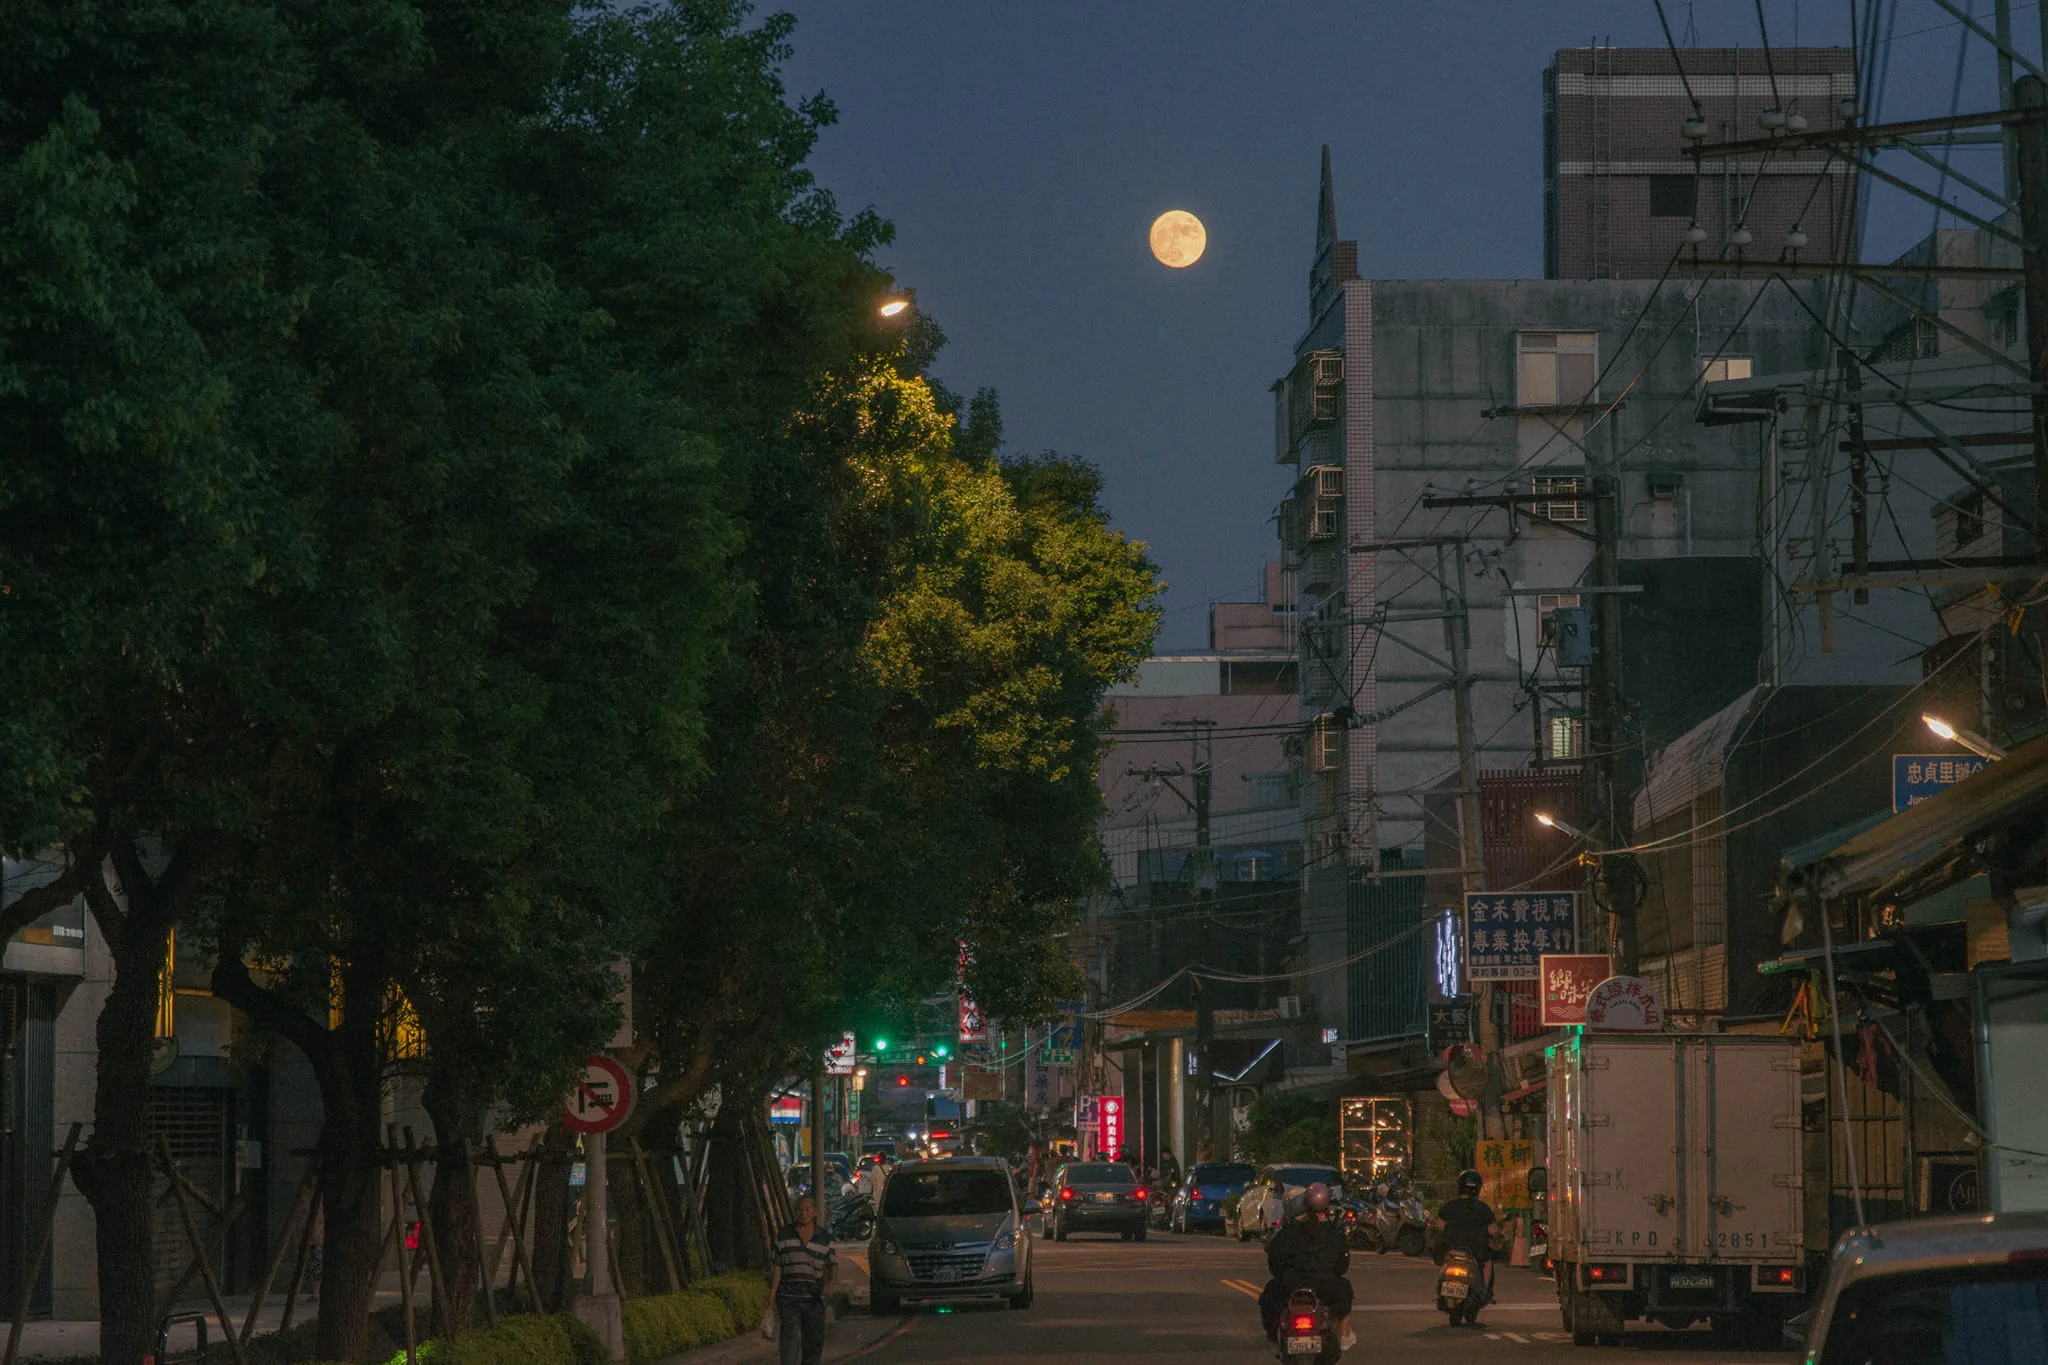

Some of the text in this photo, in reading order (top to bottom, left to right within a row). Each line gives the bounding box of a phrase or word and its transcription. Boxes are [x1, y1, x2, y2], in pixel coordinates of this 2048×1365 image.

[1472, 927, 1551, 953] 專業按摩
[1513, 966, 1540, 977] 03-4
[1616, 1231, 1767, 1248] KPD 2851
